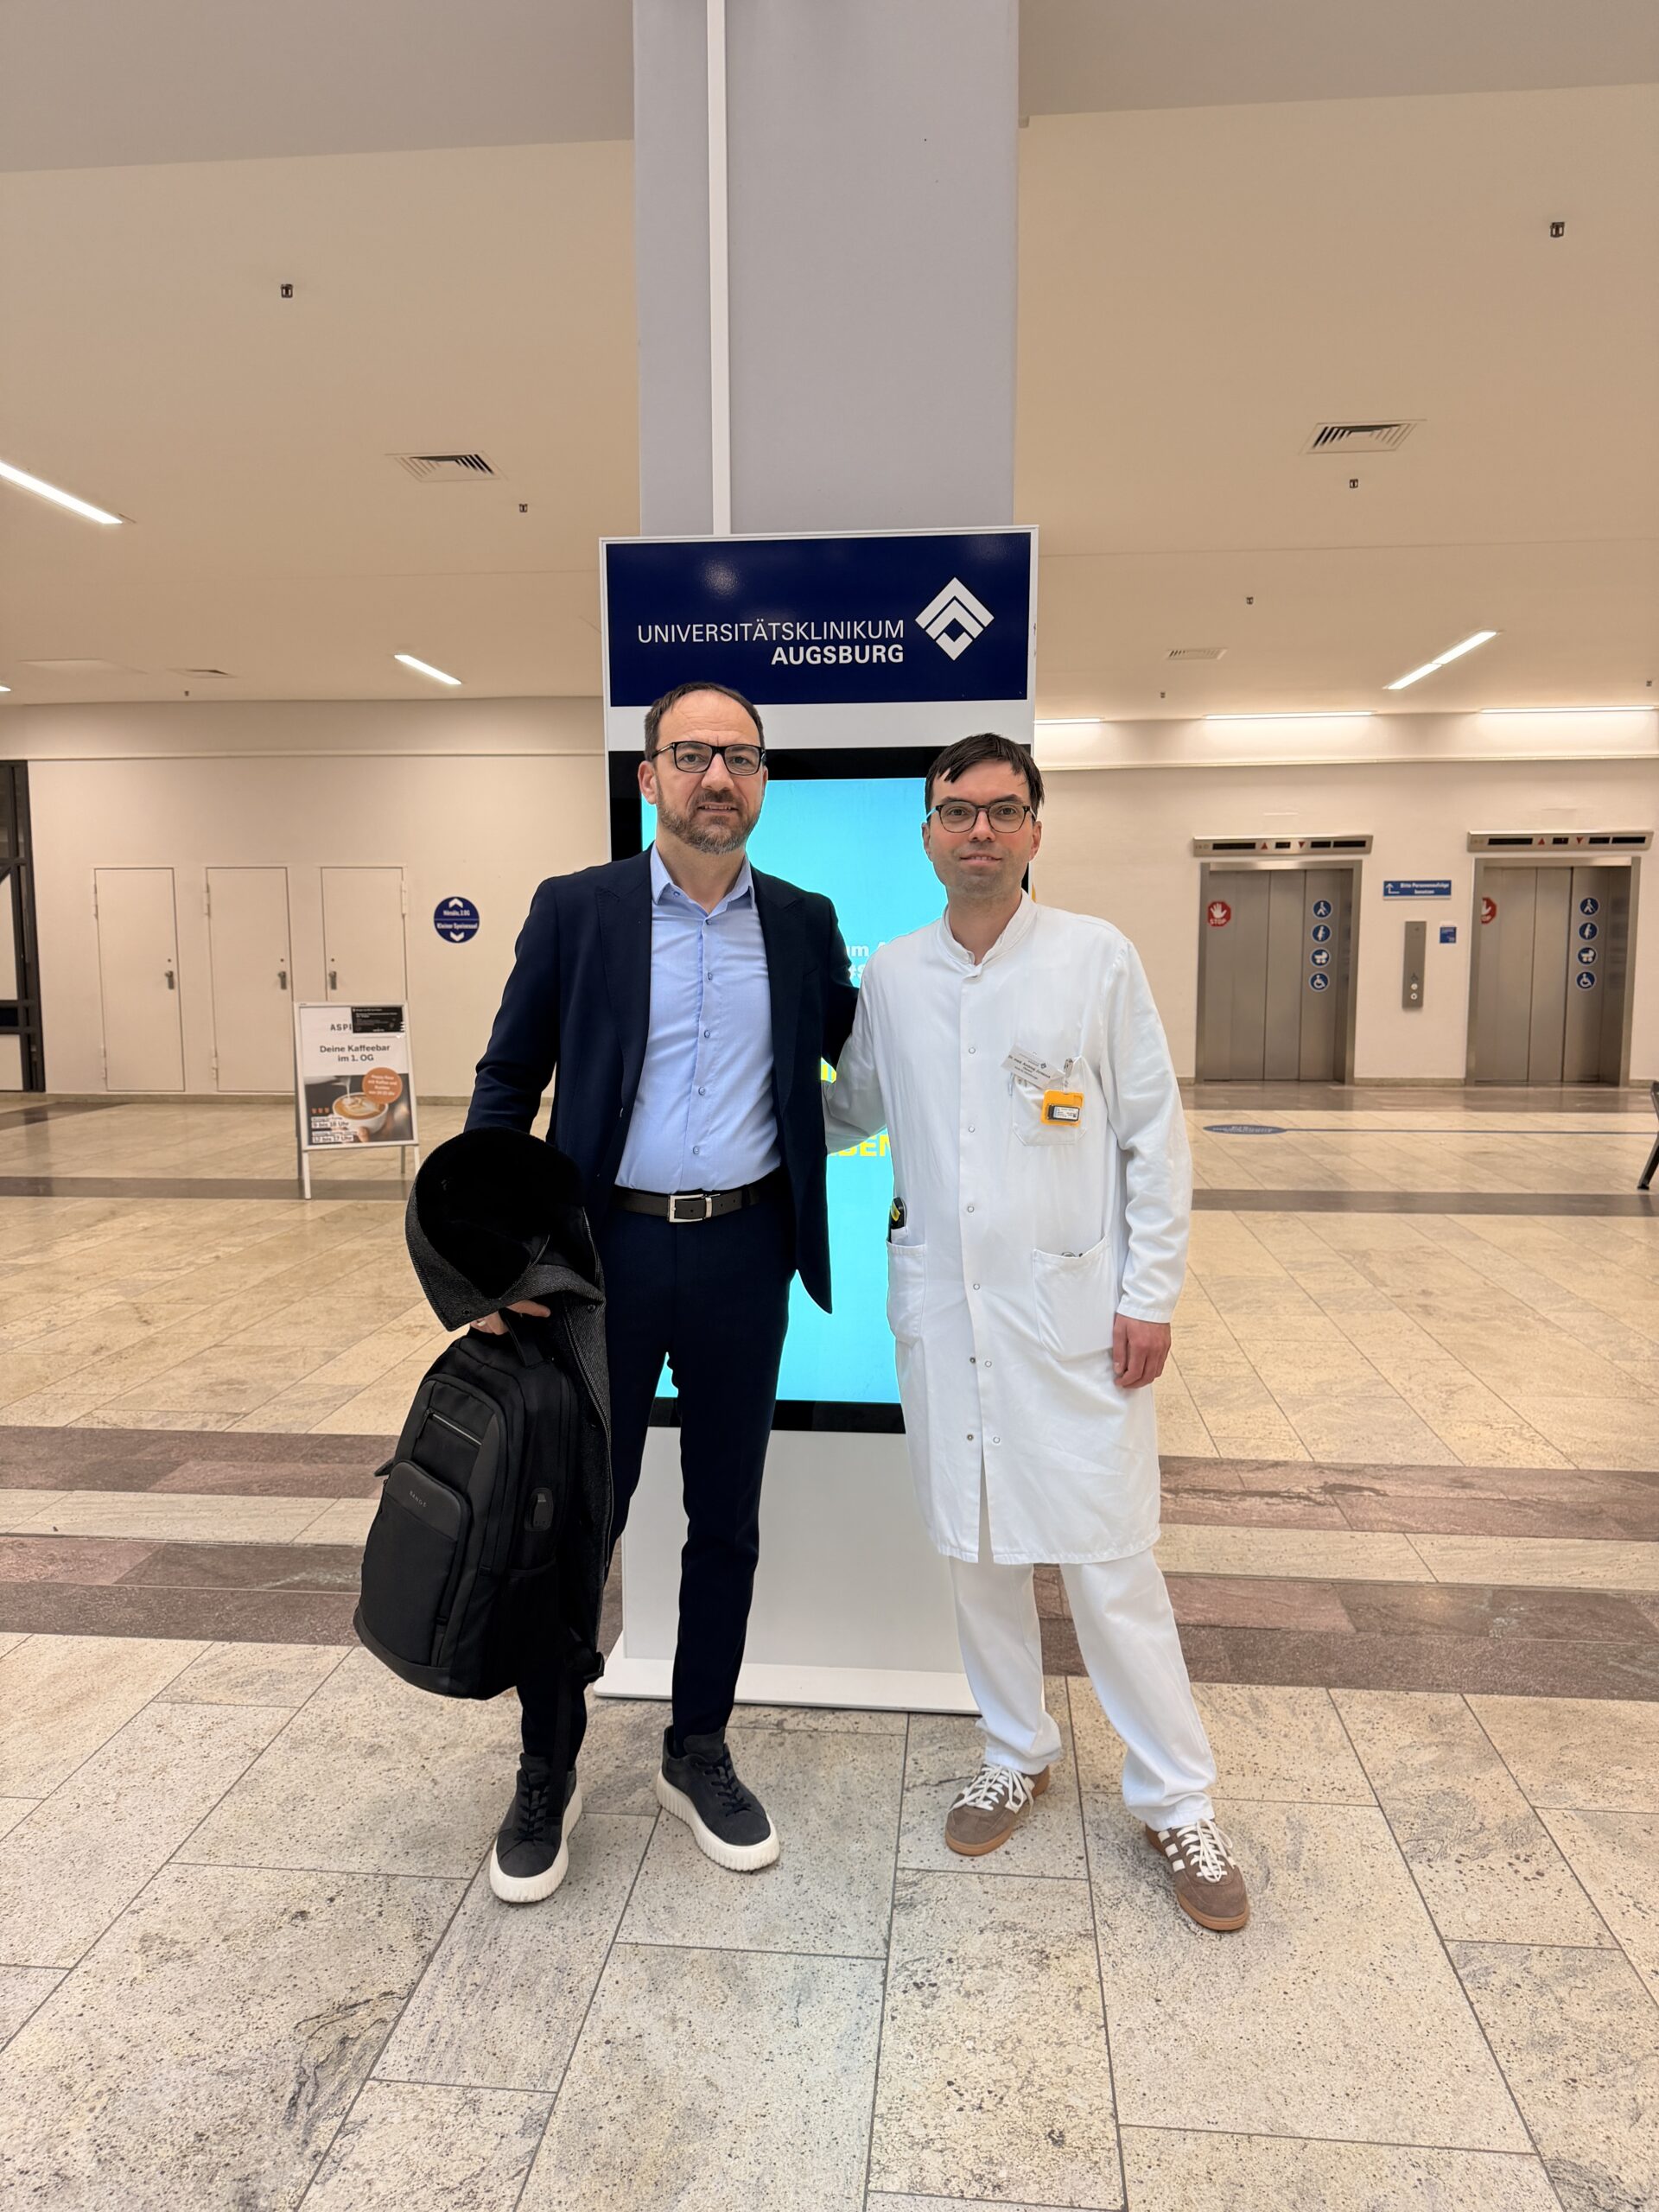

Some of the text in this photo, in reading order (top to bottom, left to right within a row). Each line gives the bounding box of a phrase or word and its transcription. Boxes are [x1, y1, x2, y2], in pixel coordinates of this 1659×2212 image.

[637, 619, 904, 643] UNIVERSITÄTSKLINIKUM
[771, 645, 904, 665] AUGSBURG
[347, 1044, 391, 1052] Kaffeebar
